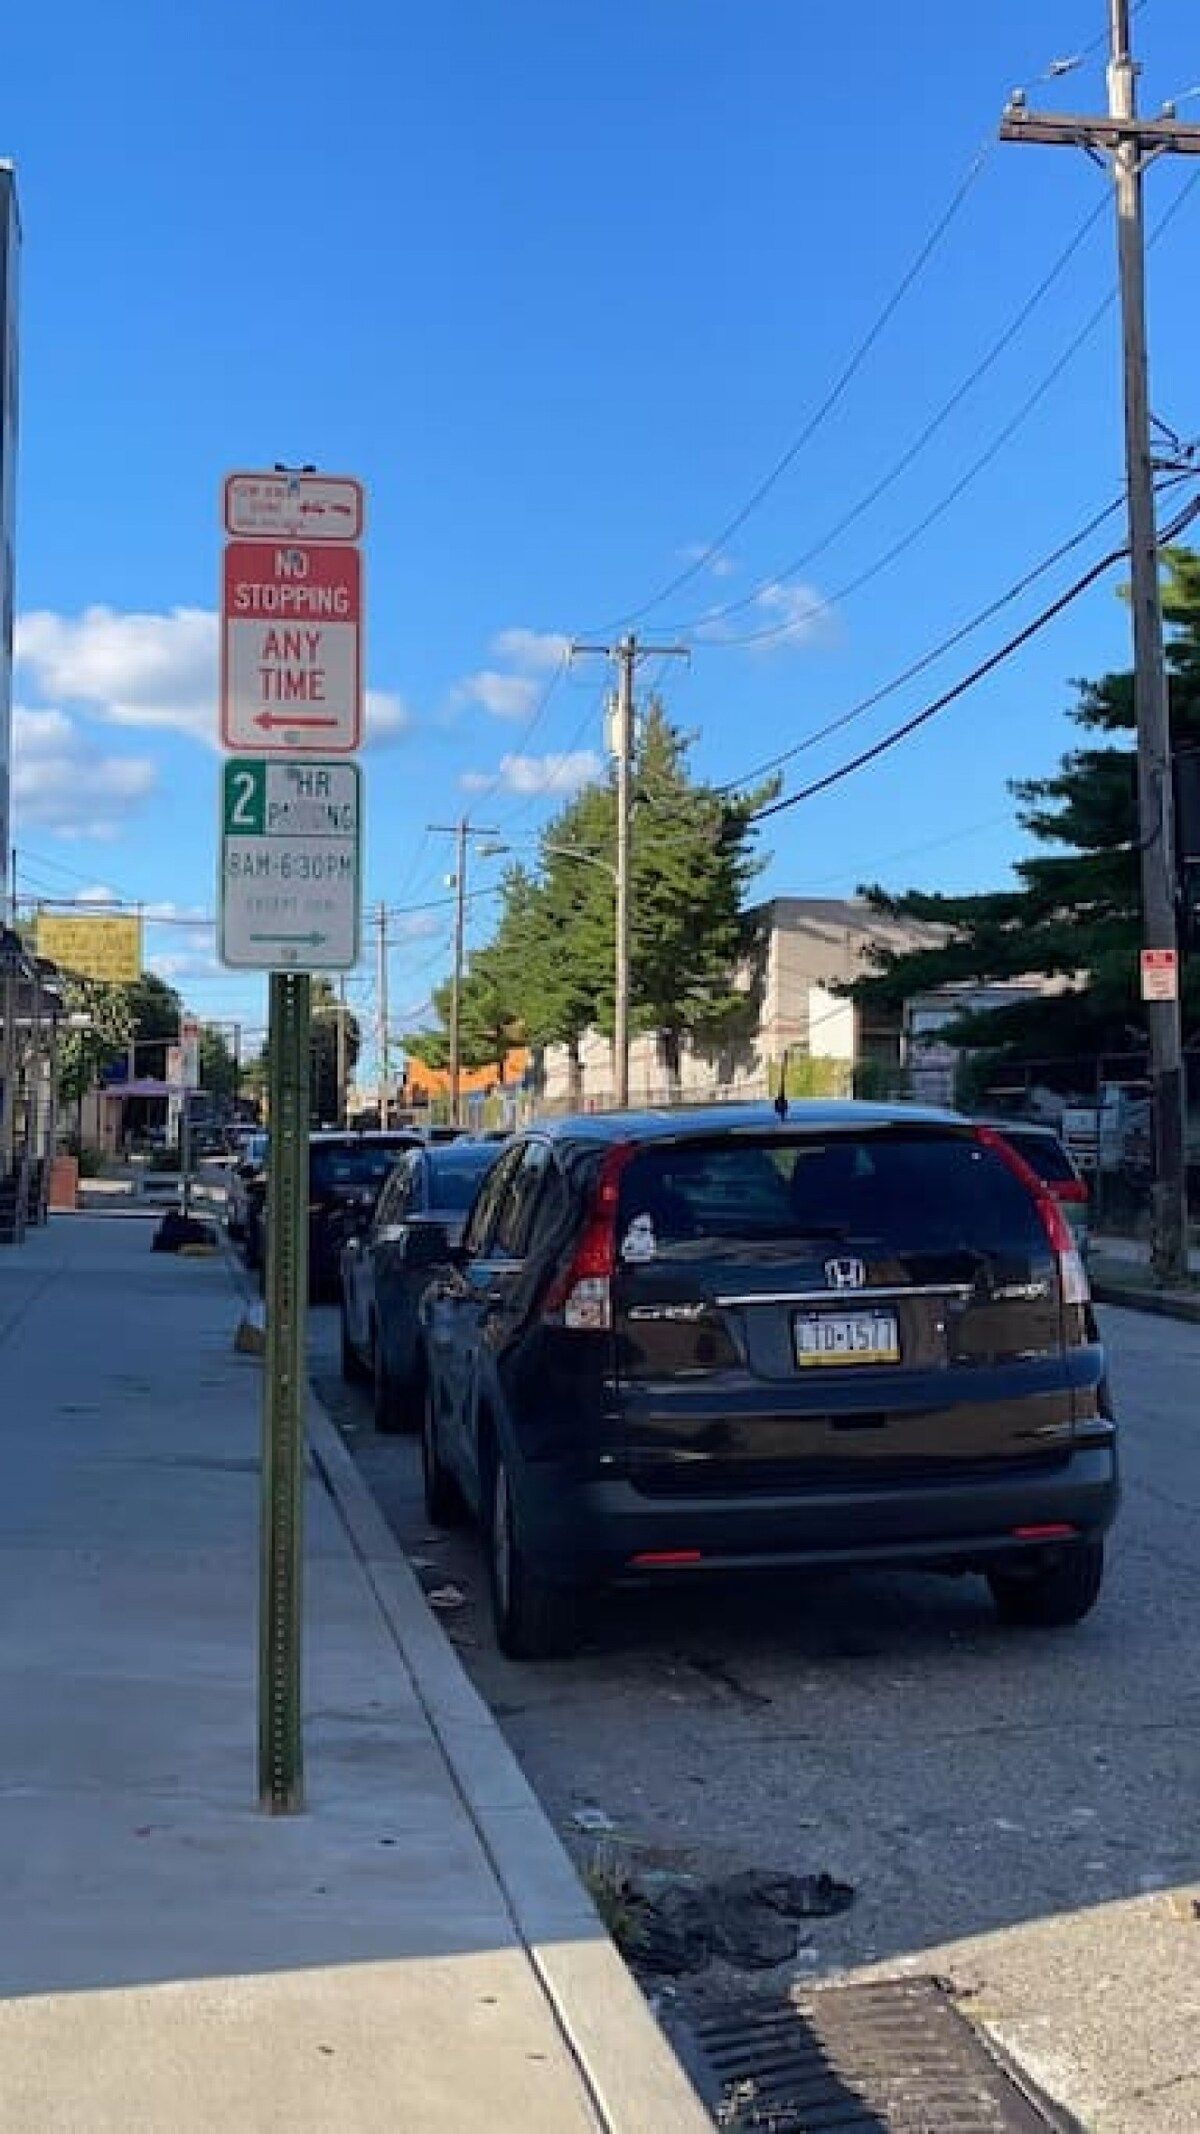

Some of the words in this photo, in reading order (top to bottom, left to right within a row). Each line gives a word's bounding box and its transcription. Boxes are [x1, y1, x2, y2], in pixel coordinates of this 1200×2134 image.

[274, 549, 310, 579] NO
[233, 582, 350, 614] STOPPING
[261, 629, 322, 663] ANY
[258, 667, 327, 701] TIME
[232, 771, 255, 823] 2
[296, 770, 329, 798] HR
